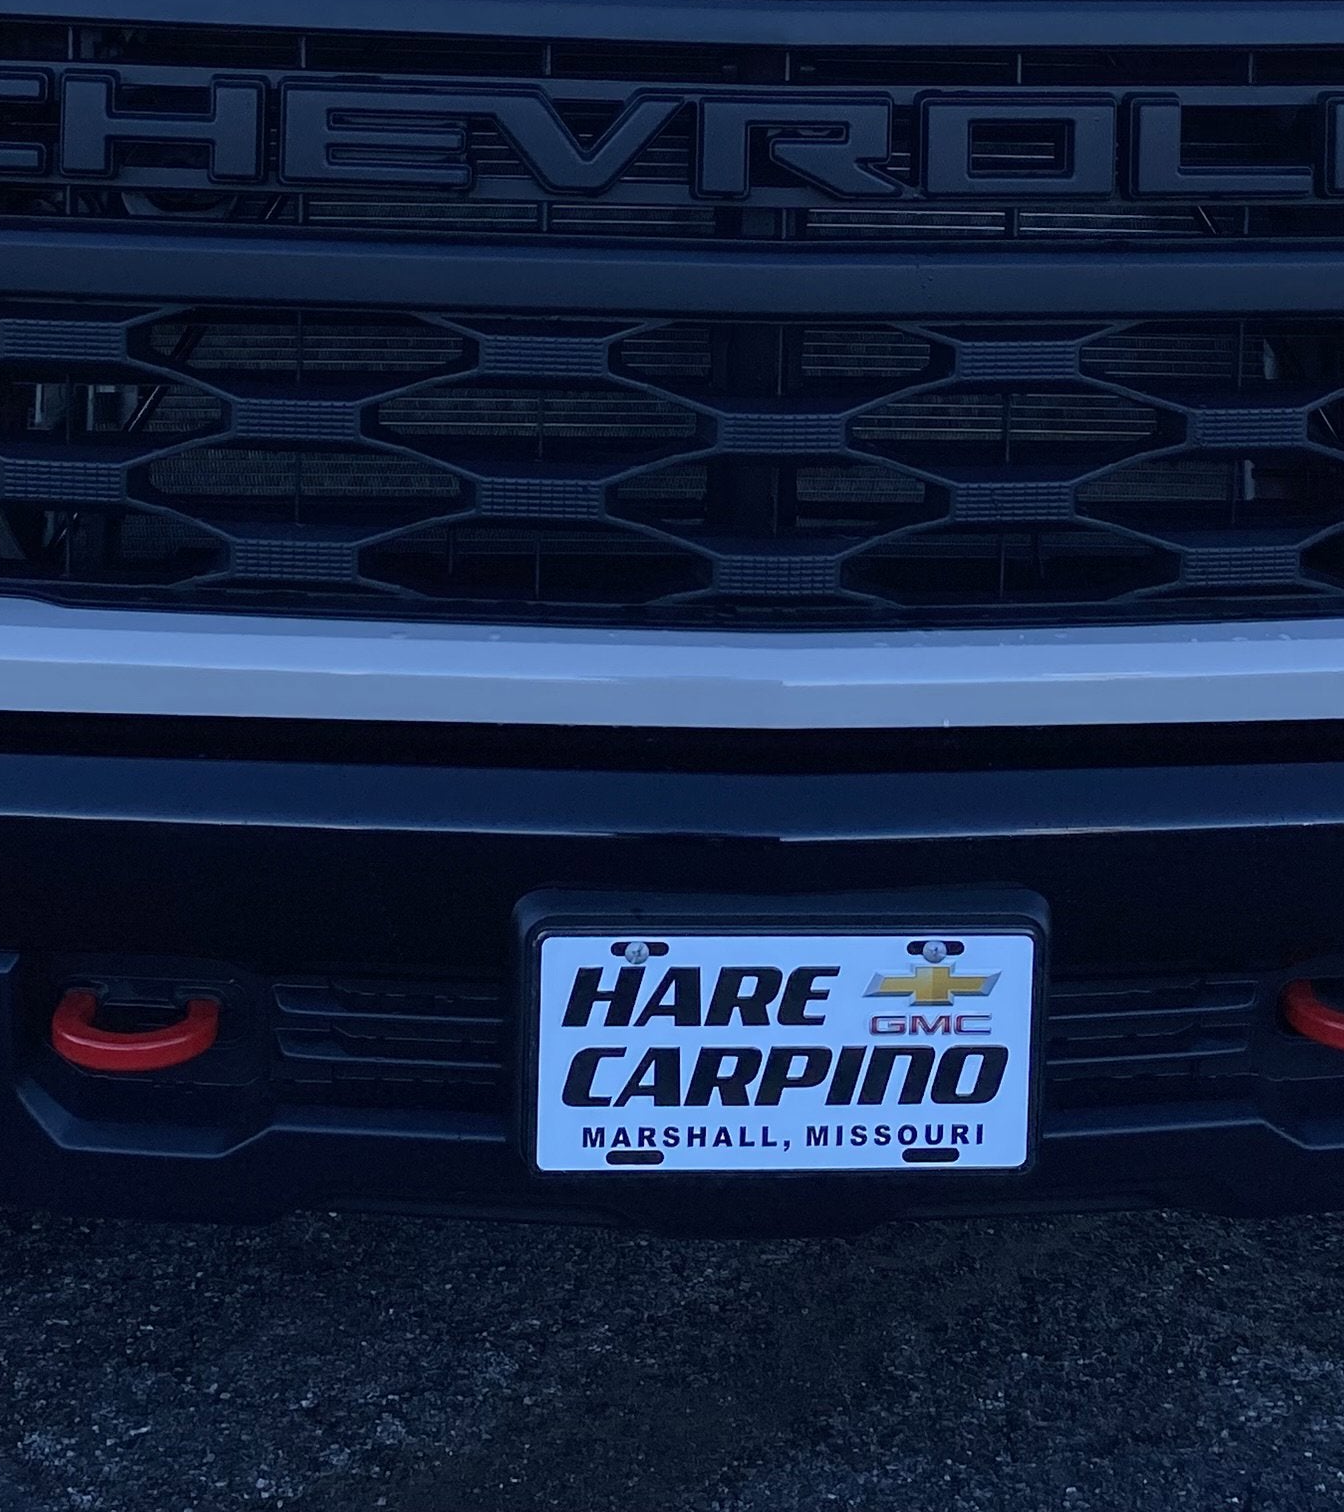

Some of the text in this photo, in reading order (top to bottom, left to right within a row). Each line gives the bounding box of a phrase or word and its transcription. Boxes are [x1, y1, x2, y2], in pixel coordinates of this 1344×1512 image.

[561, 965, 841, 1028] HARE
[868, 1013, 993, 1036] GMC
[560, 1044, 1009, 1108] CARPINO
[582, 1124, 984, 1151] MARSHALL, MISSOURI
